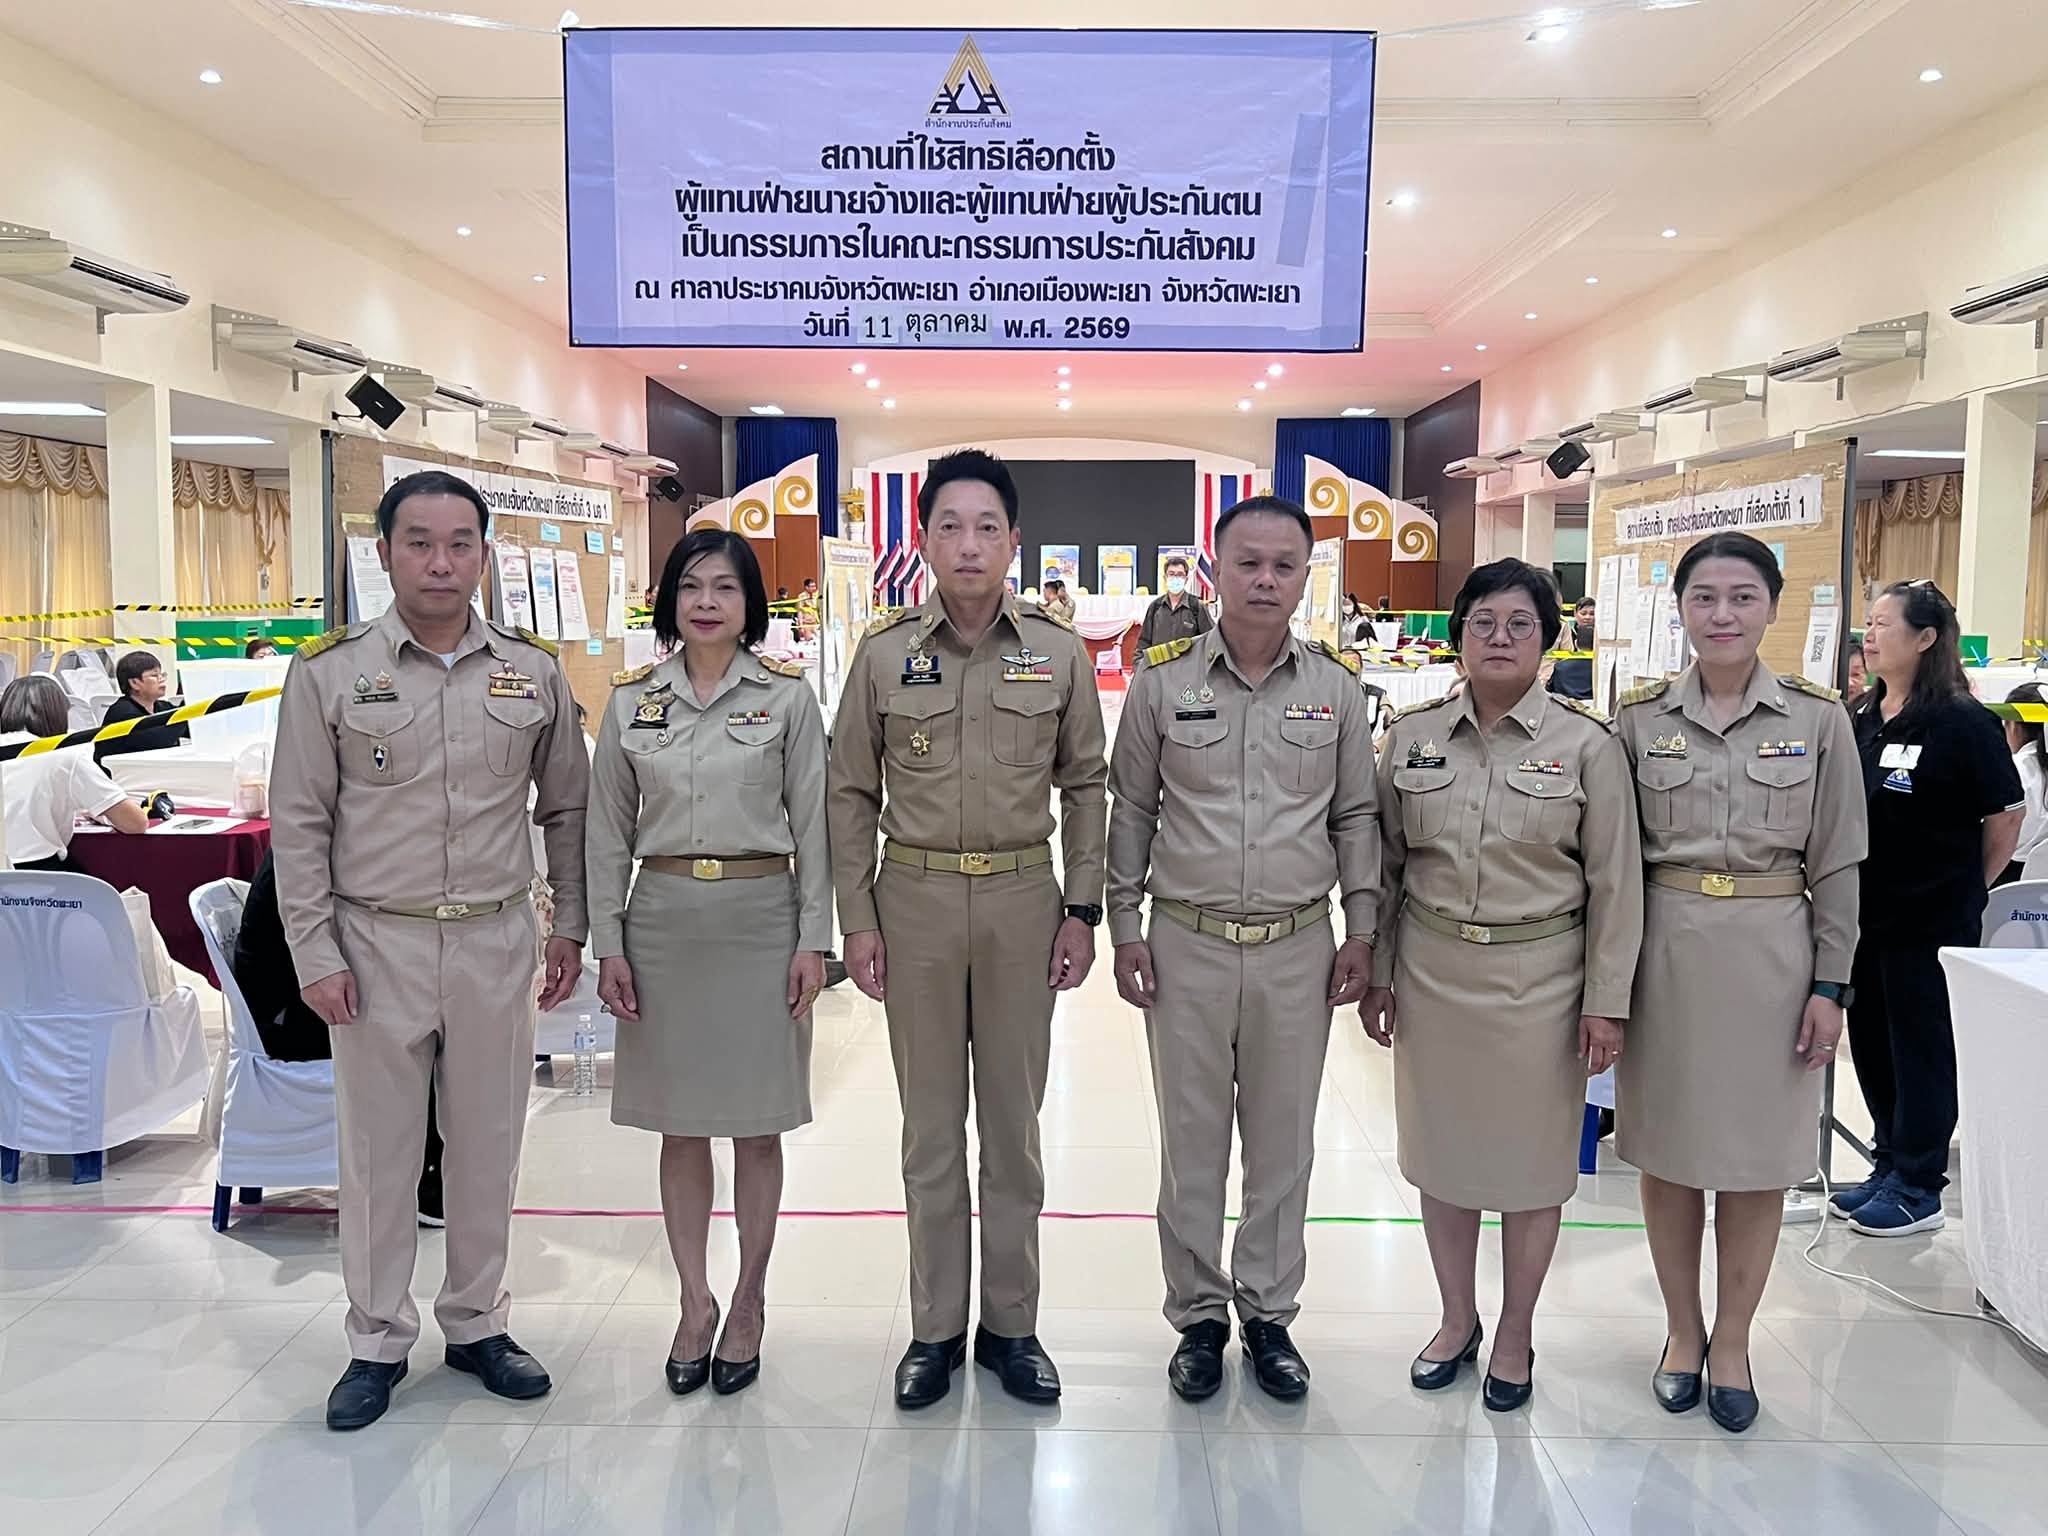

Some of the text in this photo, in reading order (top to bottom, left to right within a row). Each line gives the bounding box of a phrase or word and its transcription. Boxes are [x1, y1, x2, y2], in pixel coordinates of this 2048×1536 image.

[924, 118, 1012, 129] สำนักงานประกันสังคม
[821, 131, 1116, 171] สถานที่ใช้สิทธิเลือกตั้ง
[675, 181, 1262, 223] ผู้แทนฝ่ายนายจ้างและผู้แทนฝ่ายผู้ประกันตน
[682, 223, 1256, 261] เป็นกรรมการในคณะกรรมการประกันสังคม
[635, 275, 1301, 303] ณ ศาลาประชาคมจังหวัดพะเยา อำเภอเมืองพะเยา จังหวัดพะเยา
[803, 307, 1130, 342] วันที่ 11 ตุลาคม พ.ศ. 2569
[1746, 489, 1791, 524] ที่เลือกตั้งที่
[1799, 496, 1805, 518] 1
[0, 896, 82, 909] ำนักงานจังหวัดพะเยา
